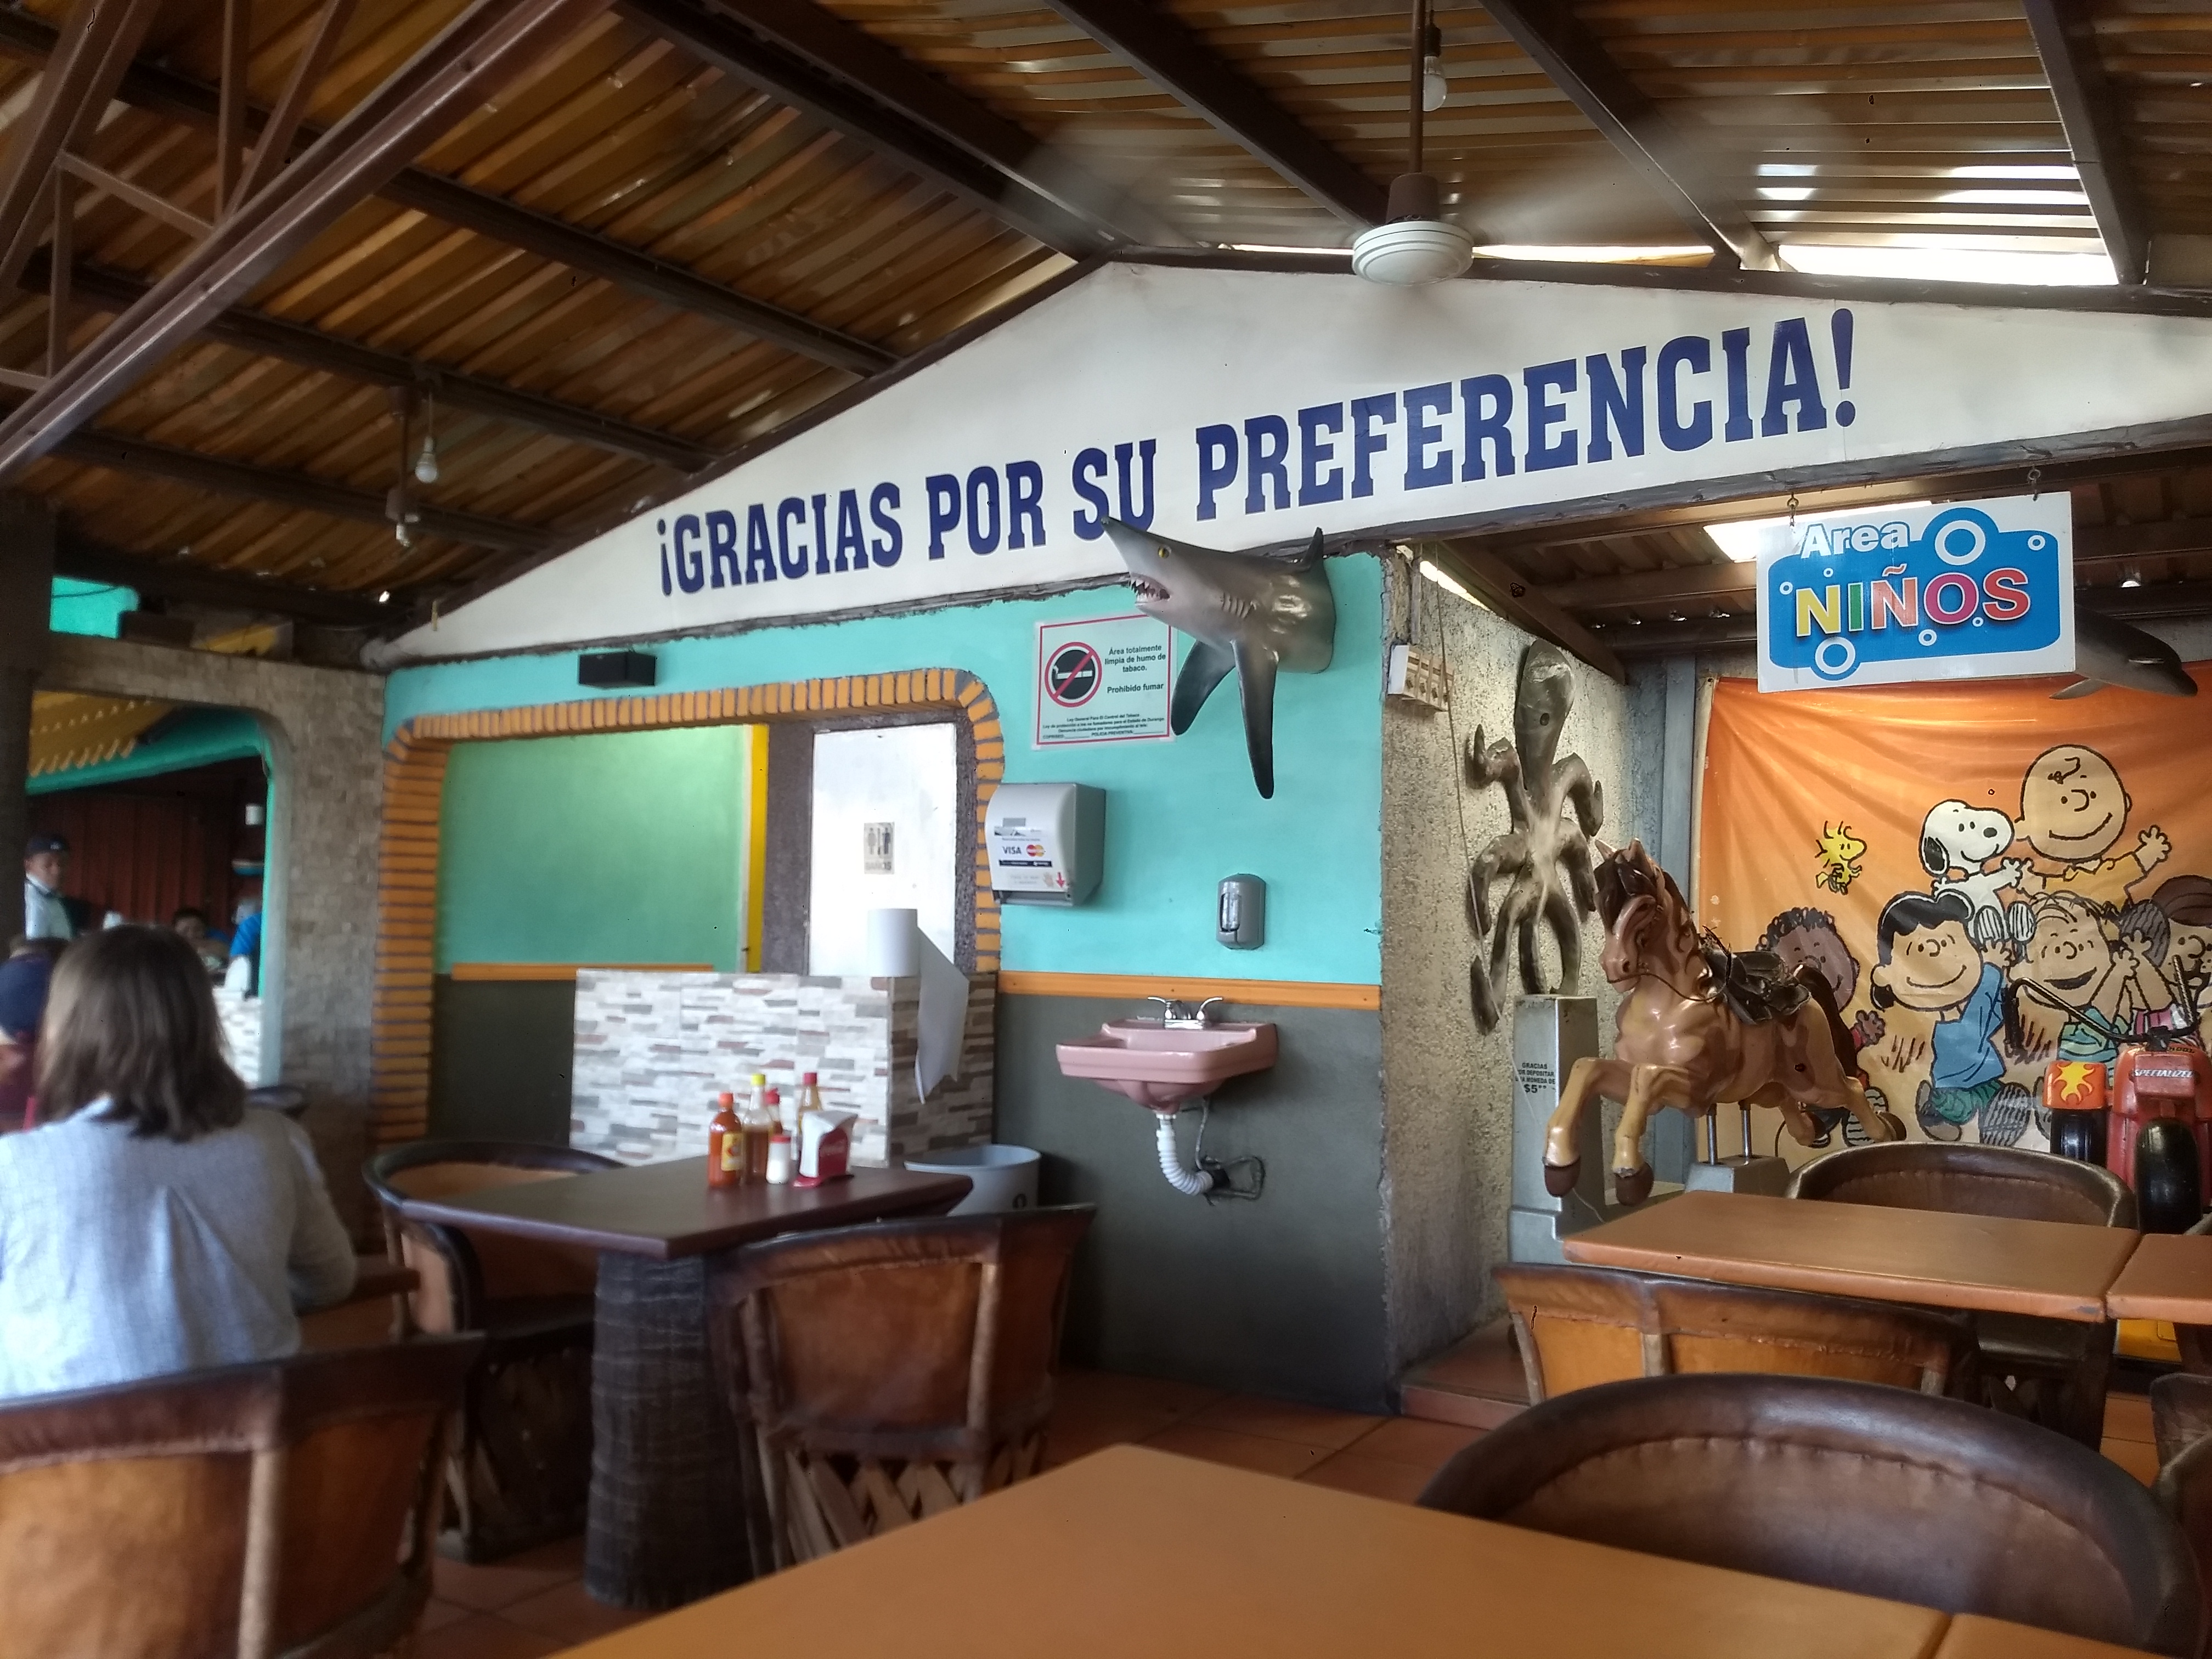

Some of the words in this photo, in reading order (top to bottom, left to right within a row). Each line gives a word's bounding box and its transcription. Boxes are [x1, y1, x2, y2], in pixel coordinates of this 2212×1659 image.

[657, 482, 902, 596] ¡GRACIAS
[926, 460, 1045, 560] POR
[1072, 438, 1156, 540] SU
[1196, 308, 1857, 522] PREFERENCIA!
[1800, 521, 1911, 559] Area
[1796, 563, 2030, 637] NIÑOS
[1109, 647, 1124, 655] Área
[1126, 645, 1162, 653] totalmente
[1107, 685, 1141, 693] Prohibido
[1002, 846, 1022, 855] VISA
